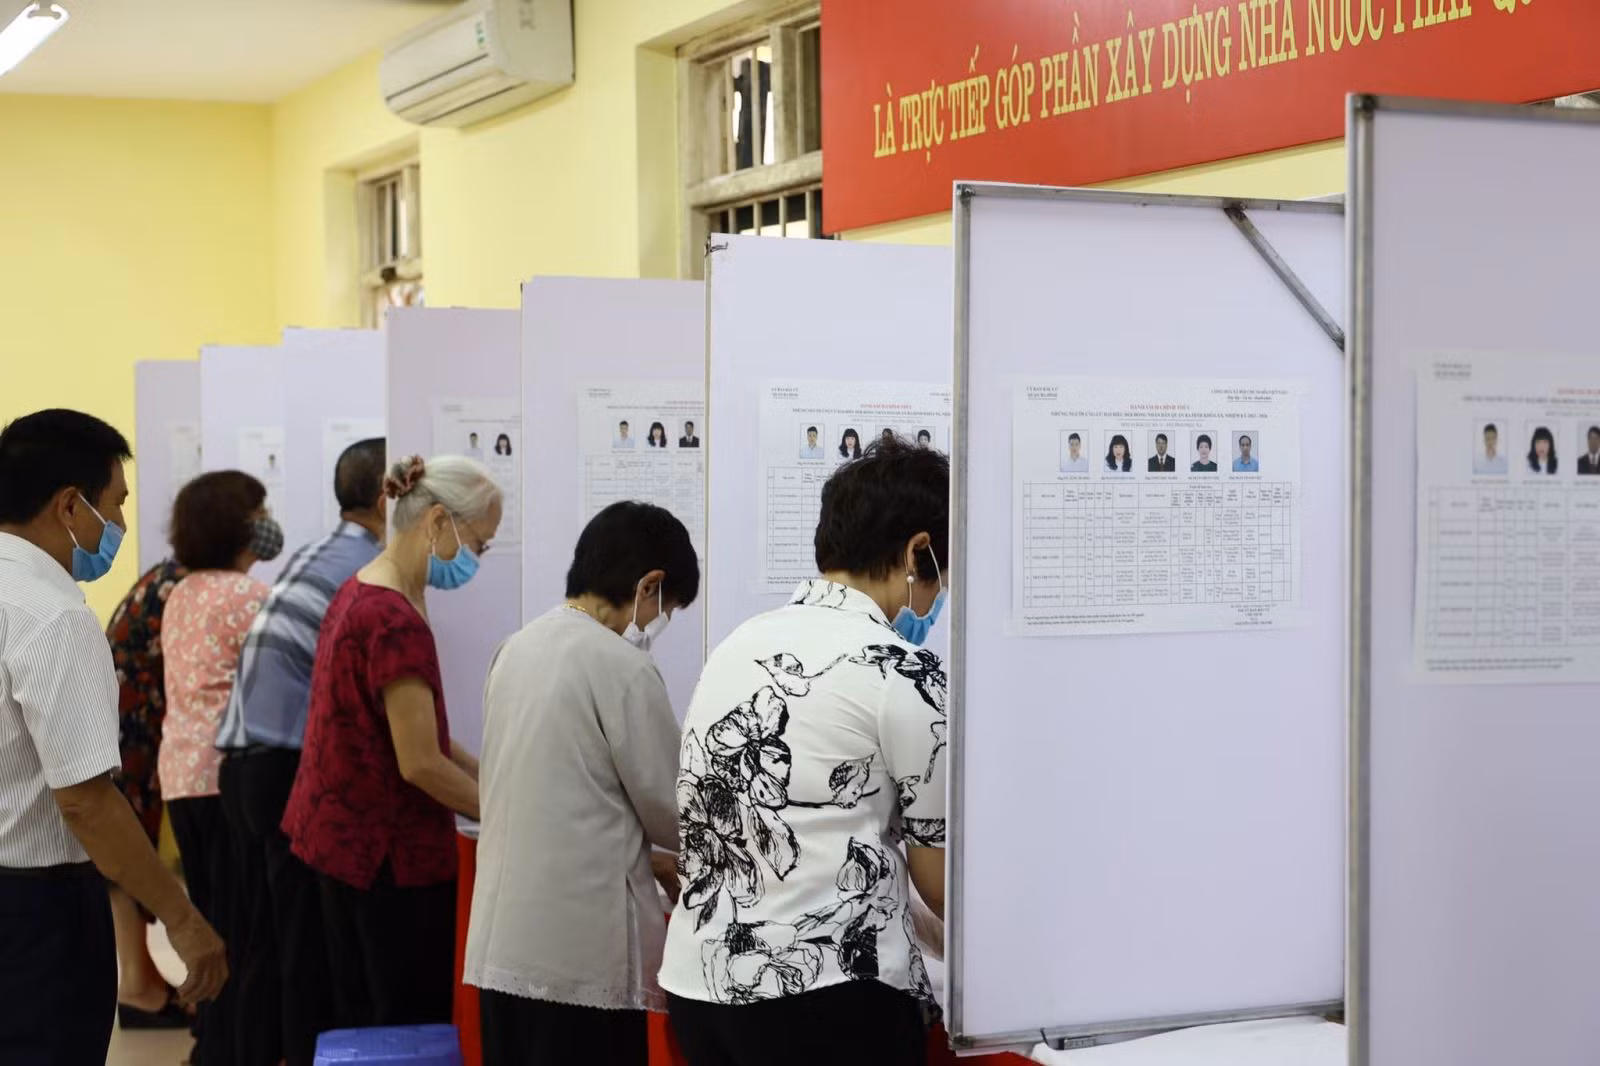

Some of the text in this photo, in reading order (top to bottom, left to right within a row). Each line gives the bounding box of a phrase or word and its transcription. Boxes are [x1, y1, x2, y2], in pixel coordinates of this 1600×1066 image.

[874, 82, 897, 158] LÀ
[899, 80, 944, 163] TRỰC
[948, 45, 990, 140] TIẾP
[995, 44, 1036, 129] GÓP
[1040, 11, 1100, 118] PHẦN
[1106, 10, 1156, 103] XÂY
[1162, 3, 1232, 104] DỰNG
